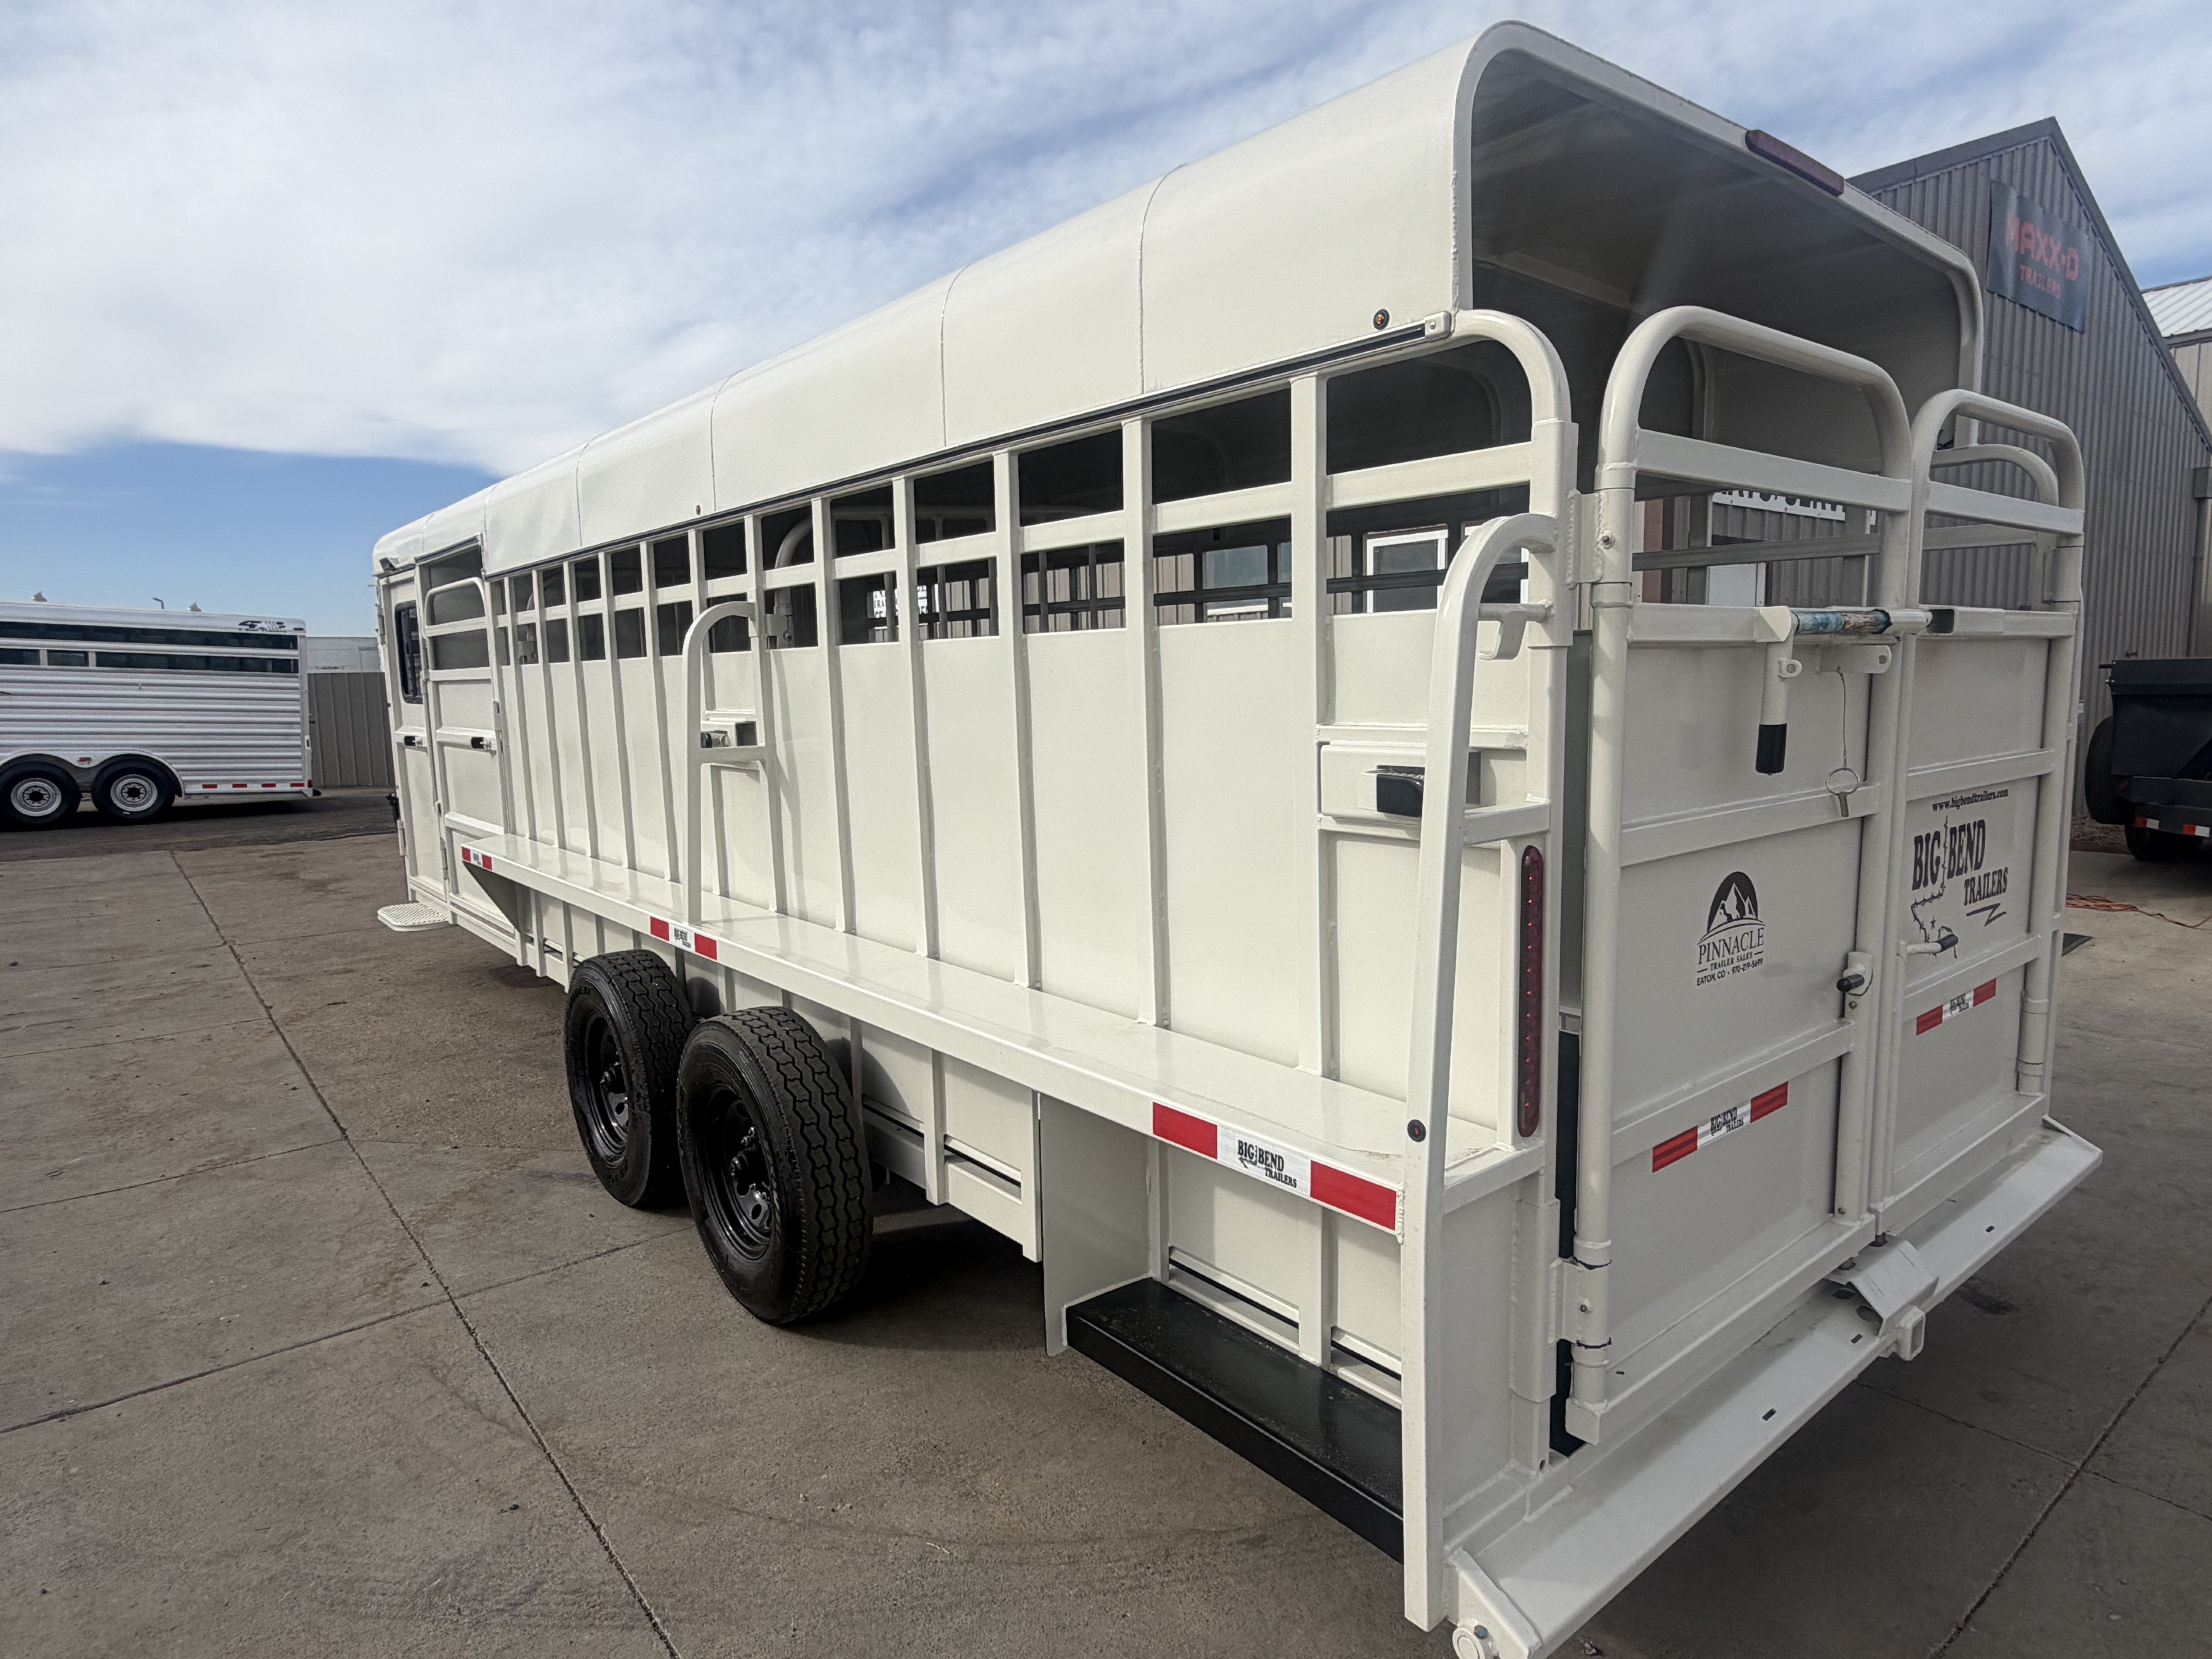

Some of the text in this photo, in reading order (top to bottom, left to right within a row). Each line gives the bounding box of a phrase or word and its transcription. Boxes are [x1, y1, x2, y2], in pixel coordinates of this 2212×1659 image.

[1912, 819, 1986, 891] BIG BEND
[1964, 867, 2008, 905] TRAILERS
[1698, 927, 1764, 965] PINNACLE
[1710, 951, 1753, 971] TRAILER SALES
[1717, 970, 1726, 979] CO
[1238, 1140, 1284, 1172] BIG BEND
[1264, 1166, 1297, 1188] TRAILERS
